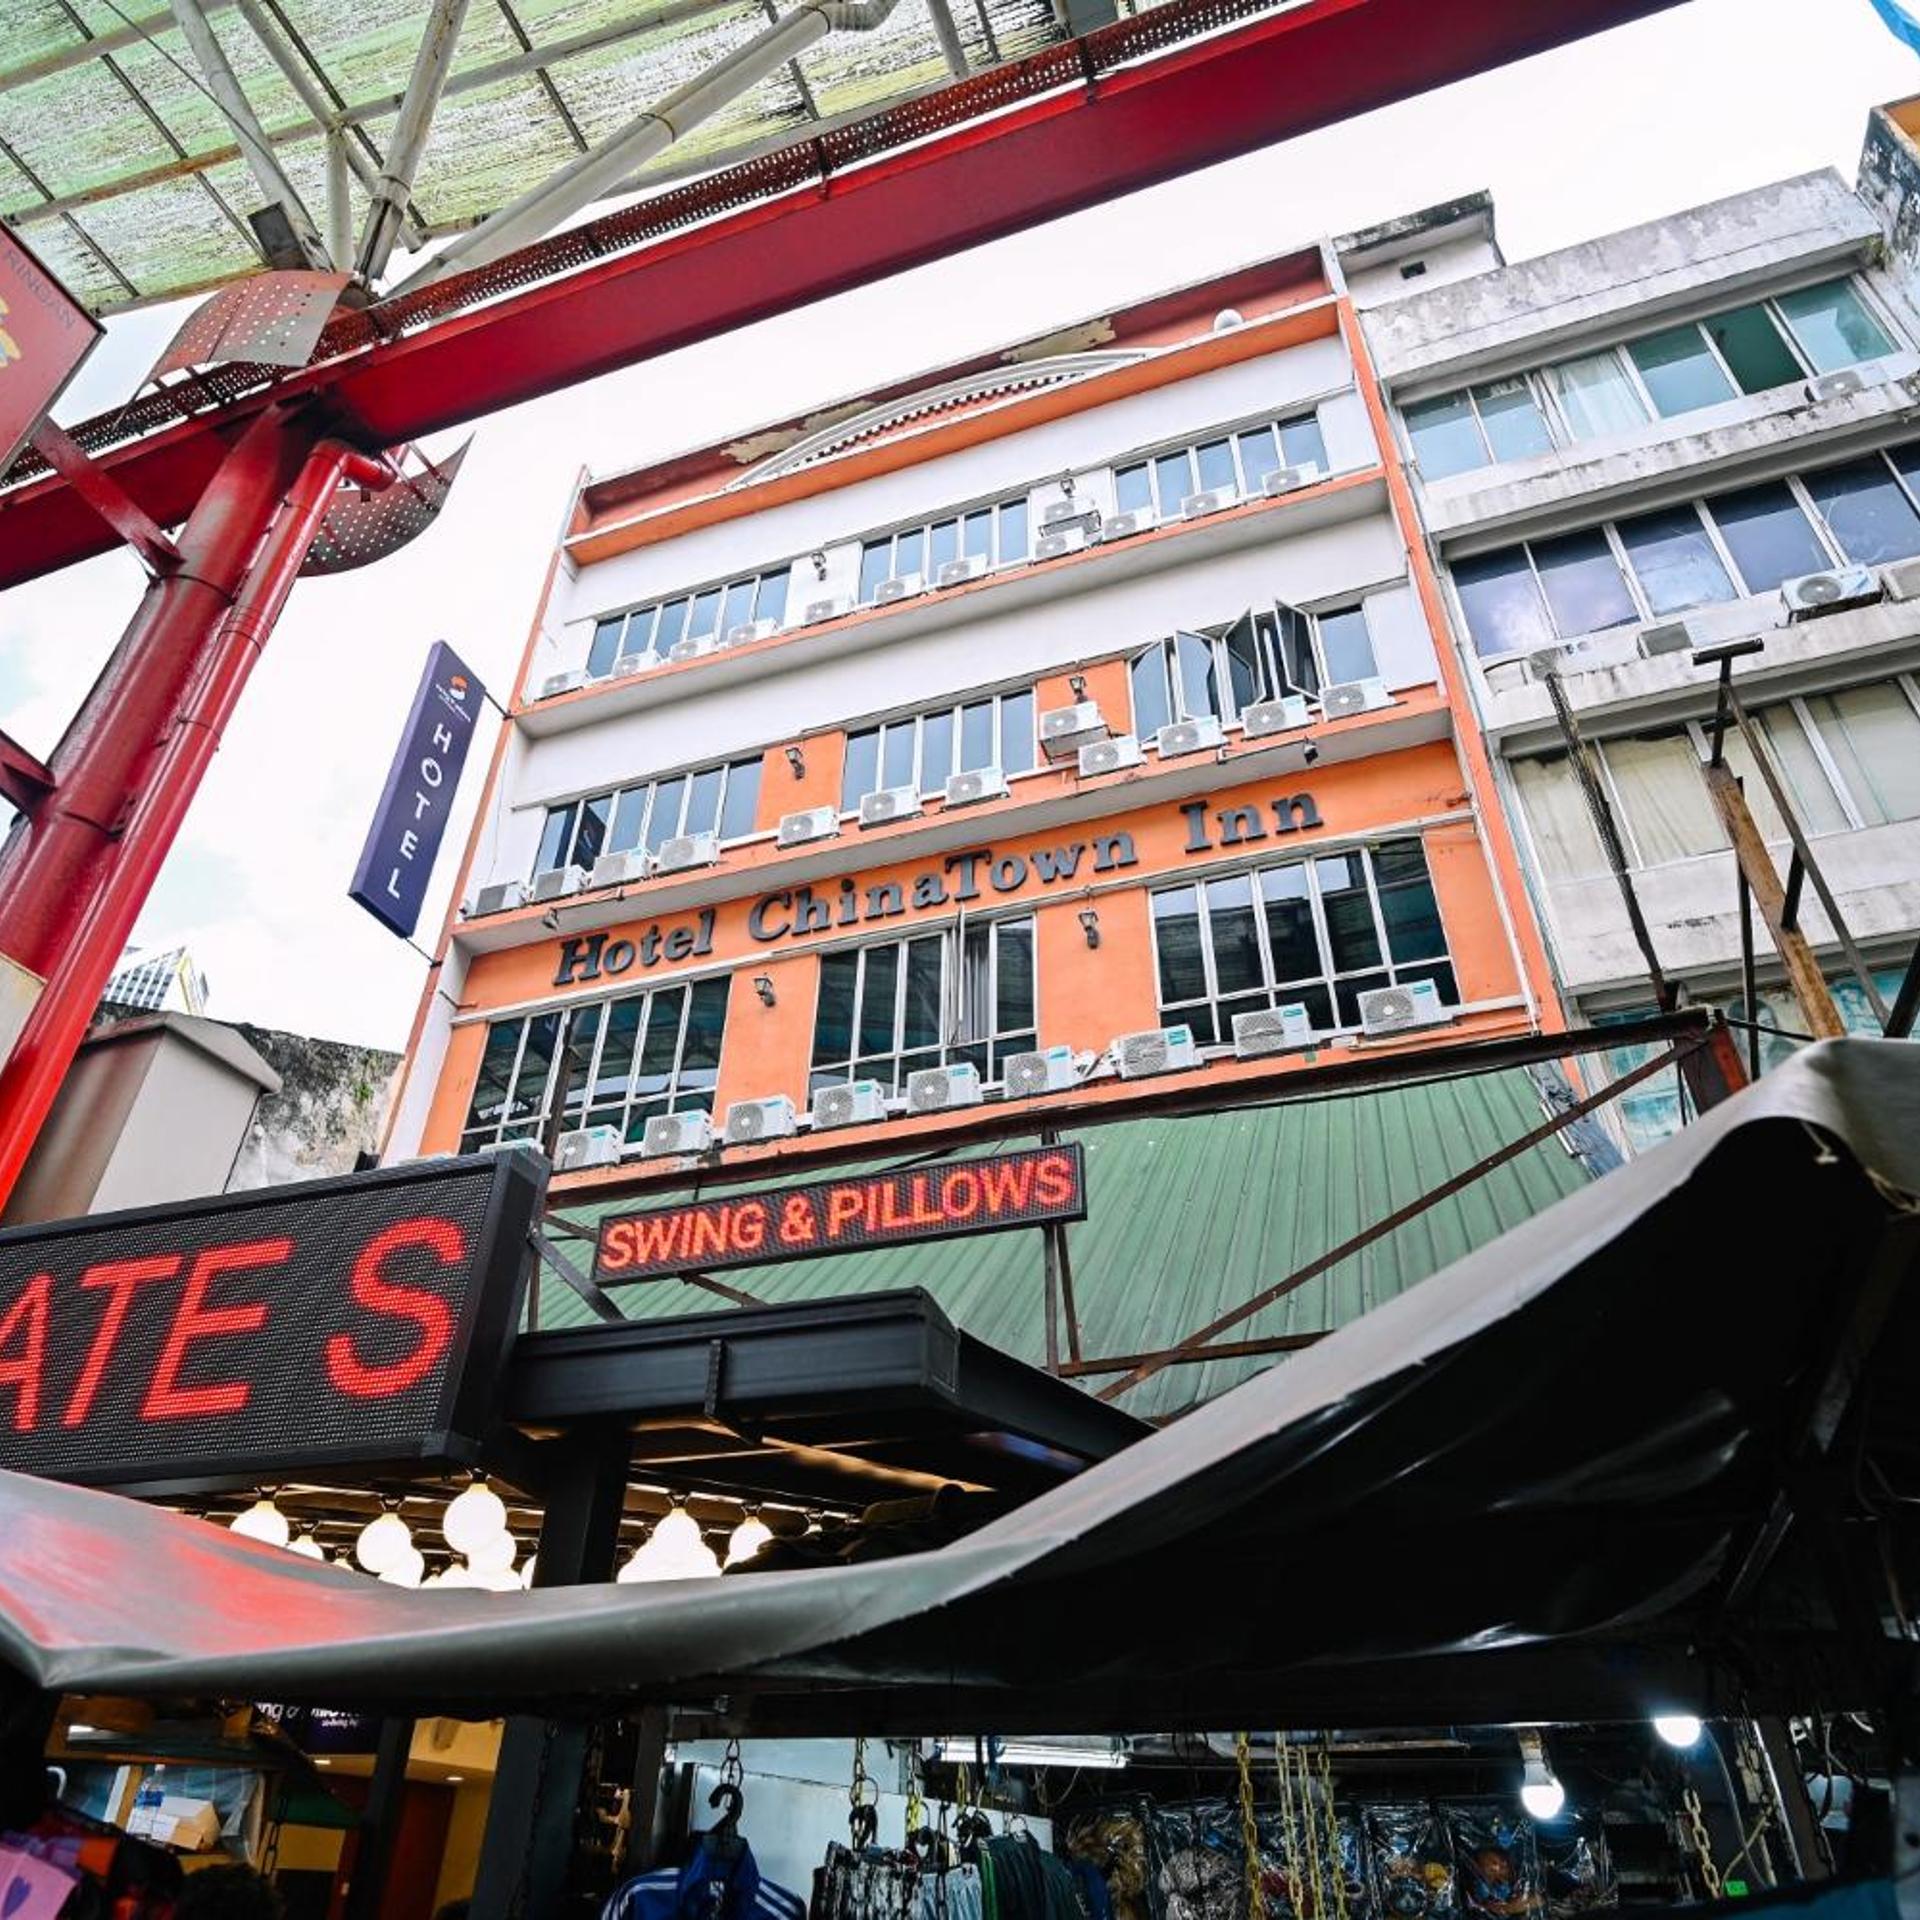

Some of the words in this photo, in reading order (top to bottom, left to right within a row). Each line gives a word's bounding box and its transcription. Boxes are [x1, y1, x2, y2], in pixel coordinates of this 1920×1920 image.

[386, 722, 453, 899] HOTEL
[552, 907, 717, 987] Hotel
[748, 829, 1139, 941] ChinaTown
[1179, 791, 1324, 854] Inn
[601, 1203, 766, 1271] SWING
[779, 1192, 815, 1244] &
[827, 1153, 1077, 1237] PILLOWS
[322, 1215, 467, 1399] S
